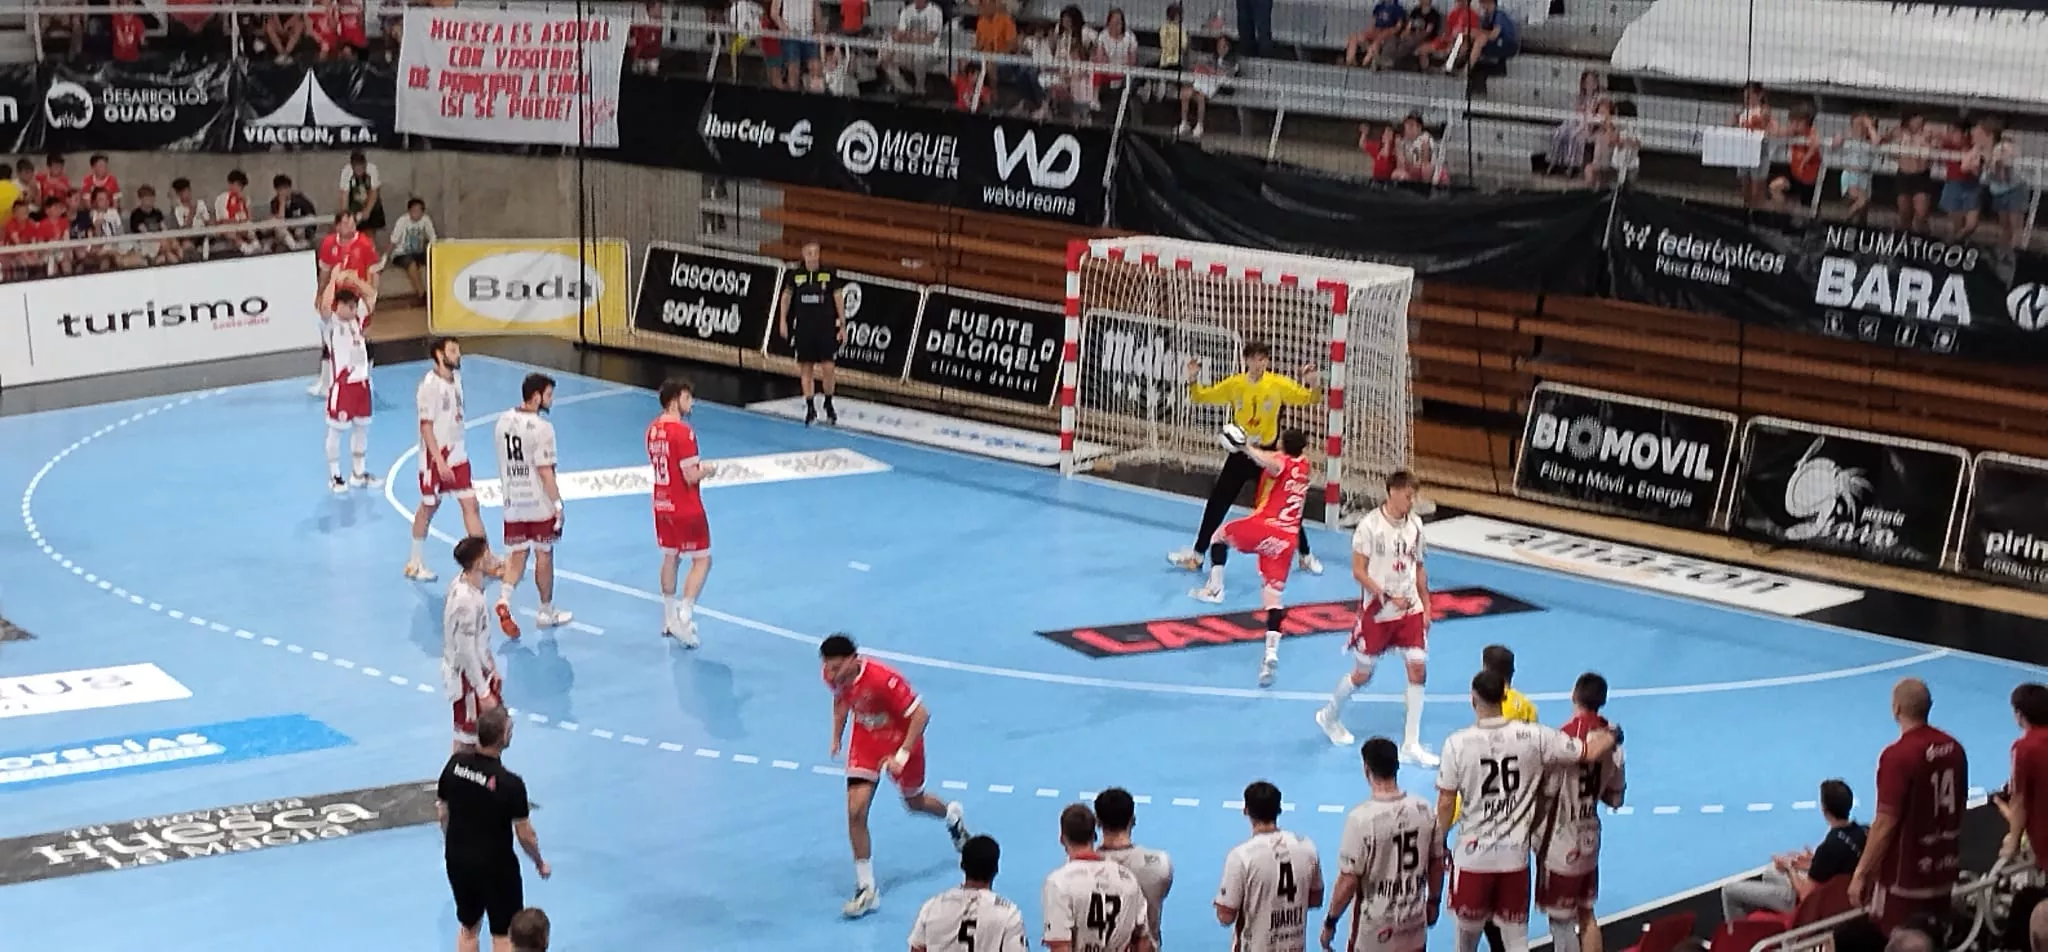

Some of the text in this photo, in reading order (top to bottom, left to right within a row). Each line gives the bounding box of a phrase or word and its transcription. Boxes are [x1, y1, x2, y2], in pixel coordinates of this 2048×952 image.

[449, 46, 484, 68] CON
[528, 71, 541, 96] A
[880, 128, 960, 166] MIGUEL
[983, 184, 1077, 216] webdreams
[468, 273, 593, 302] Bada
[670, 252, 752, 297] lasaosa
[1815, 255, 1971, 326] BARA
[57, 295, 269, 338] turismo
[503, 432, 525, 461] 18
[1539, 459, 1577, 484] Fibra
[1484, 530, 1794, 596] amazon
[1480, 755, 1520, 798] 26
[1930, 768, 1956, 817] 14
[31, 803, 380, 866] Huesca
[1392, 829, 1420, 871] 15
[1276, 861, 1298, 903] 4
[957, 919, 978, 952] 5
